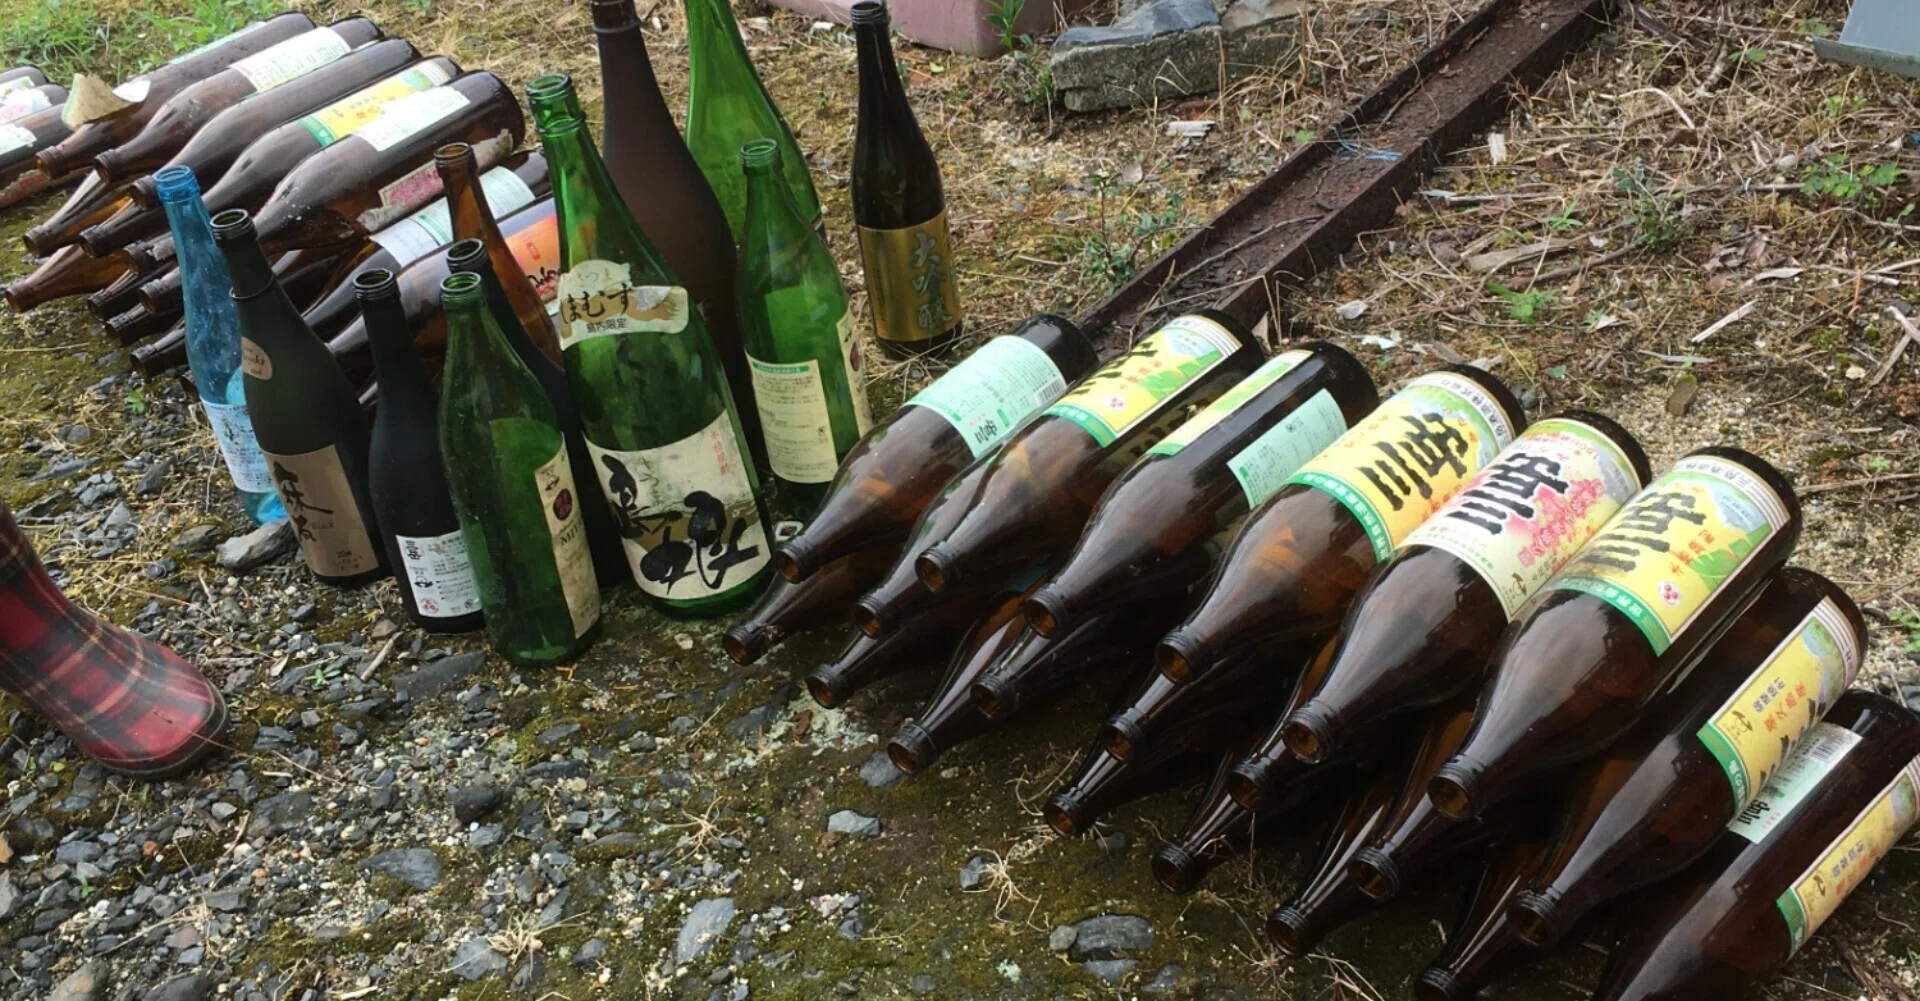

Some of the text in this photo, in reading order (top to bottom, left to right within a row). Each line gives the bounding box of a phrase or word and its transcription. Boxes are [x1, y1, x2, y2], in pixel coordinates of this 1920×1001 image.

[909, 231, 954, 329] 大吟醸
[1354, 412, 1468, 512] 三岳
[1444, 453, 1569, 535] 三岳
[1579, 491, 1707, 571] 三岳
